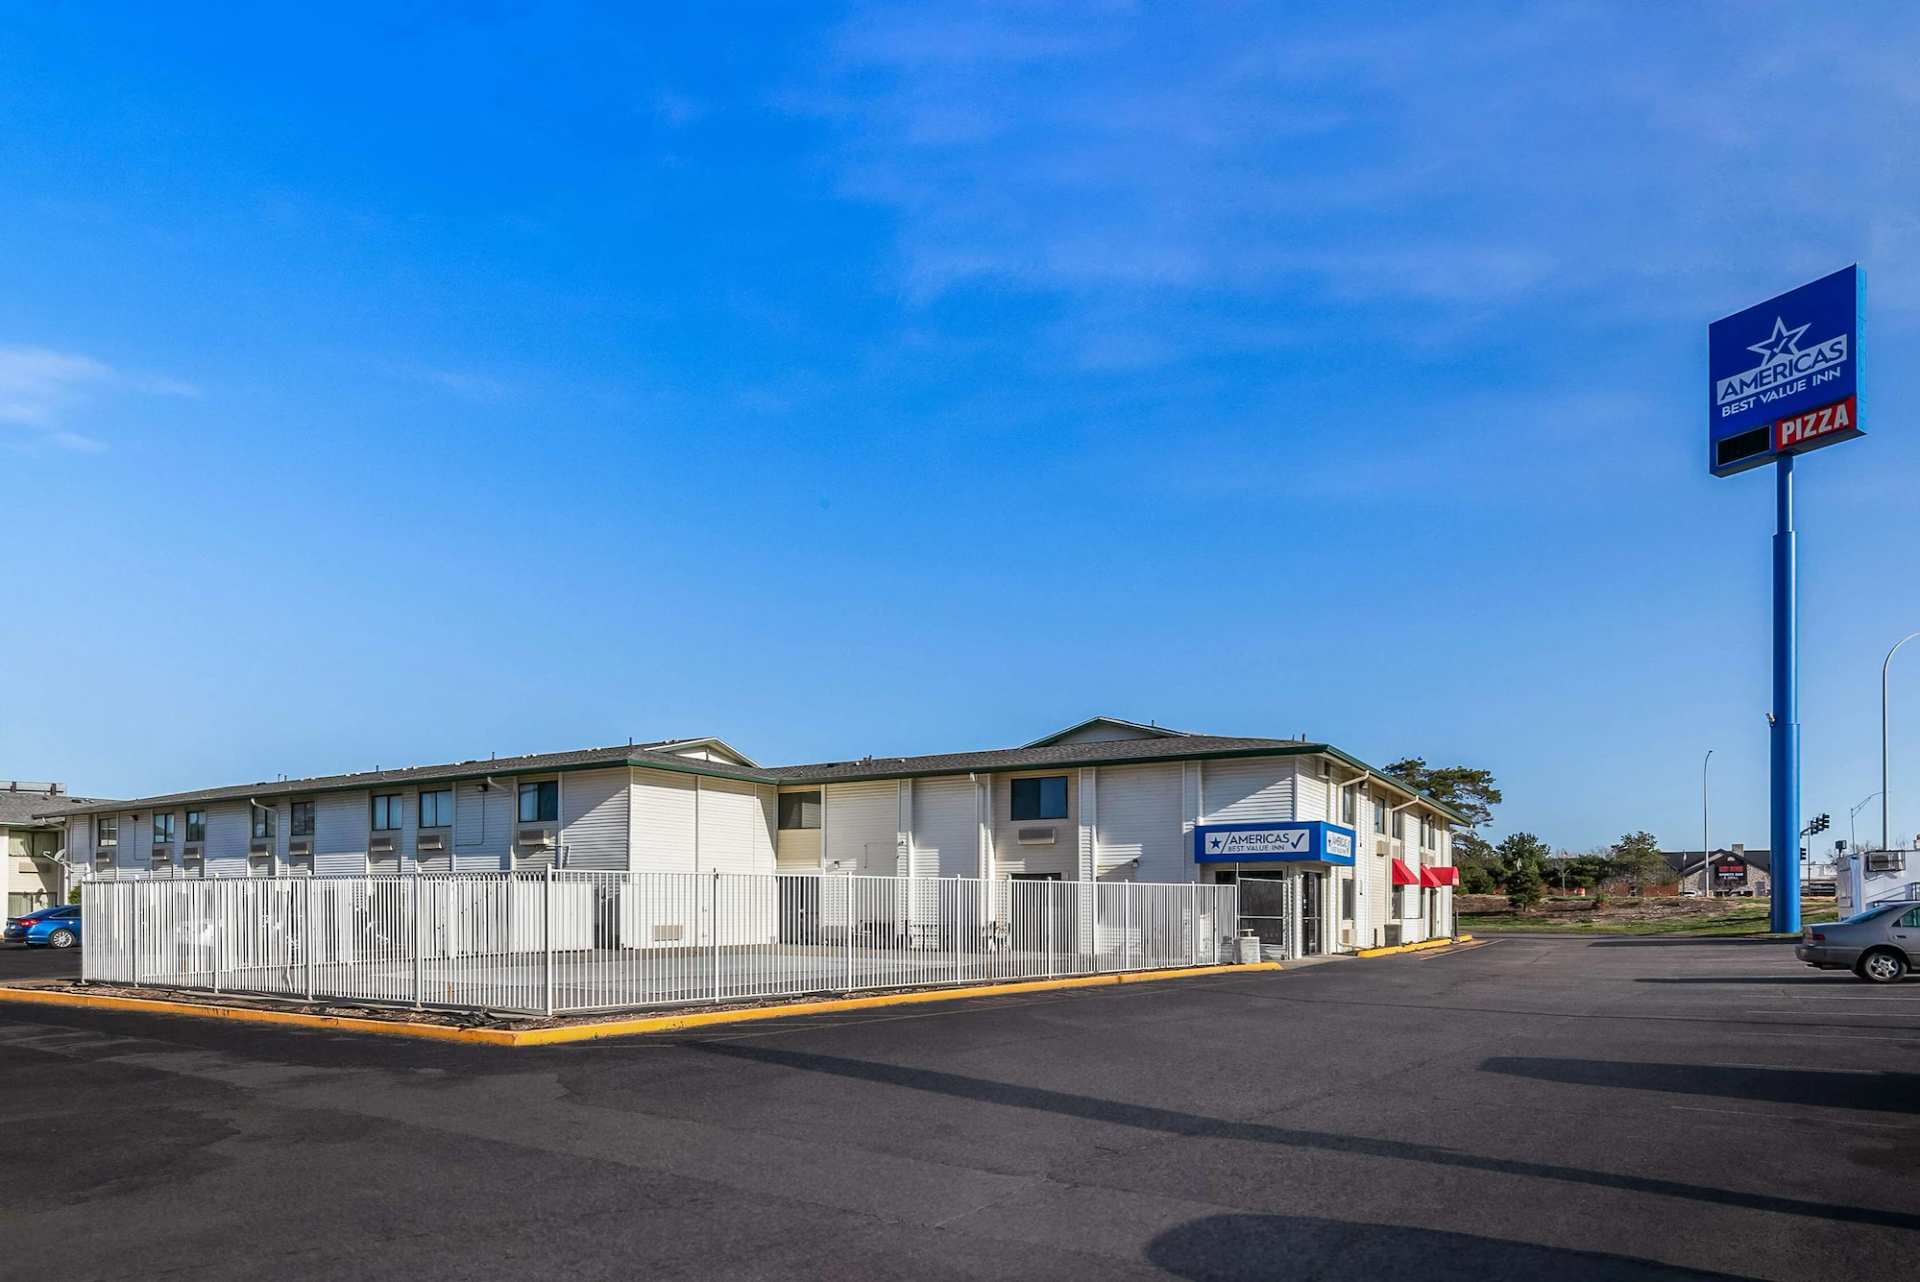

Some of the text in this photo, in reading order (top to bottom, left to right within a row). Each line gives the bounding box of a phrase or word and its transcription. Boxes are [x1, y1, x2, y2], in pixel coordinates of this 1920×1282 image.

[1721, 341, 1844, 400] AMERICAS
[1722, 367, 1840, 417] BEST VALUE INN
[1781, 403, 1849, 445] PIZZA
[1229, 833, 1290, 844] AMERICAS
